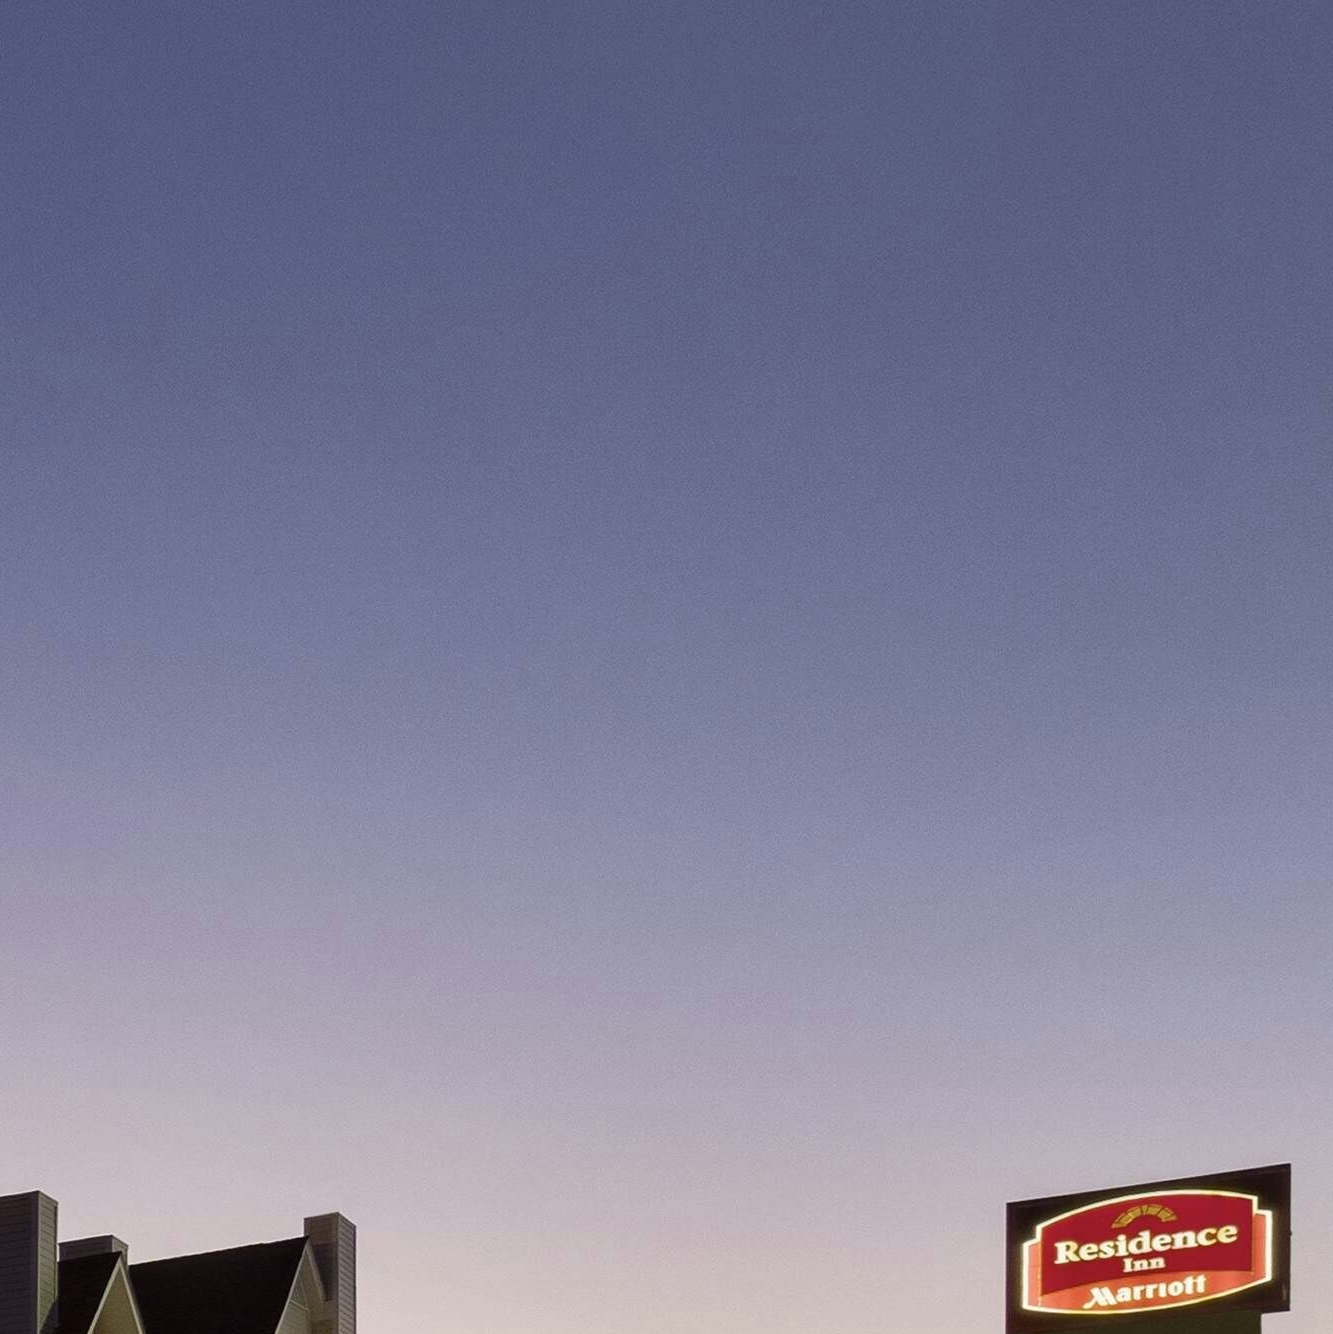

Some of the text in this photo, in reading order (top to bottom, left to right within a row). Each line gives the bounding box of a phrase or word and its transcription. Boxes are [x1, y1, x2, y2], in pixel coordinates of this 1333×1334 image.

[1054, 1224, 1238, 1264] Residence
[1123, 1257, 1165, 1273] Inn
[1083, 1274, 1207, 1309] Marriott
